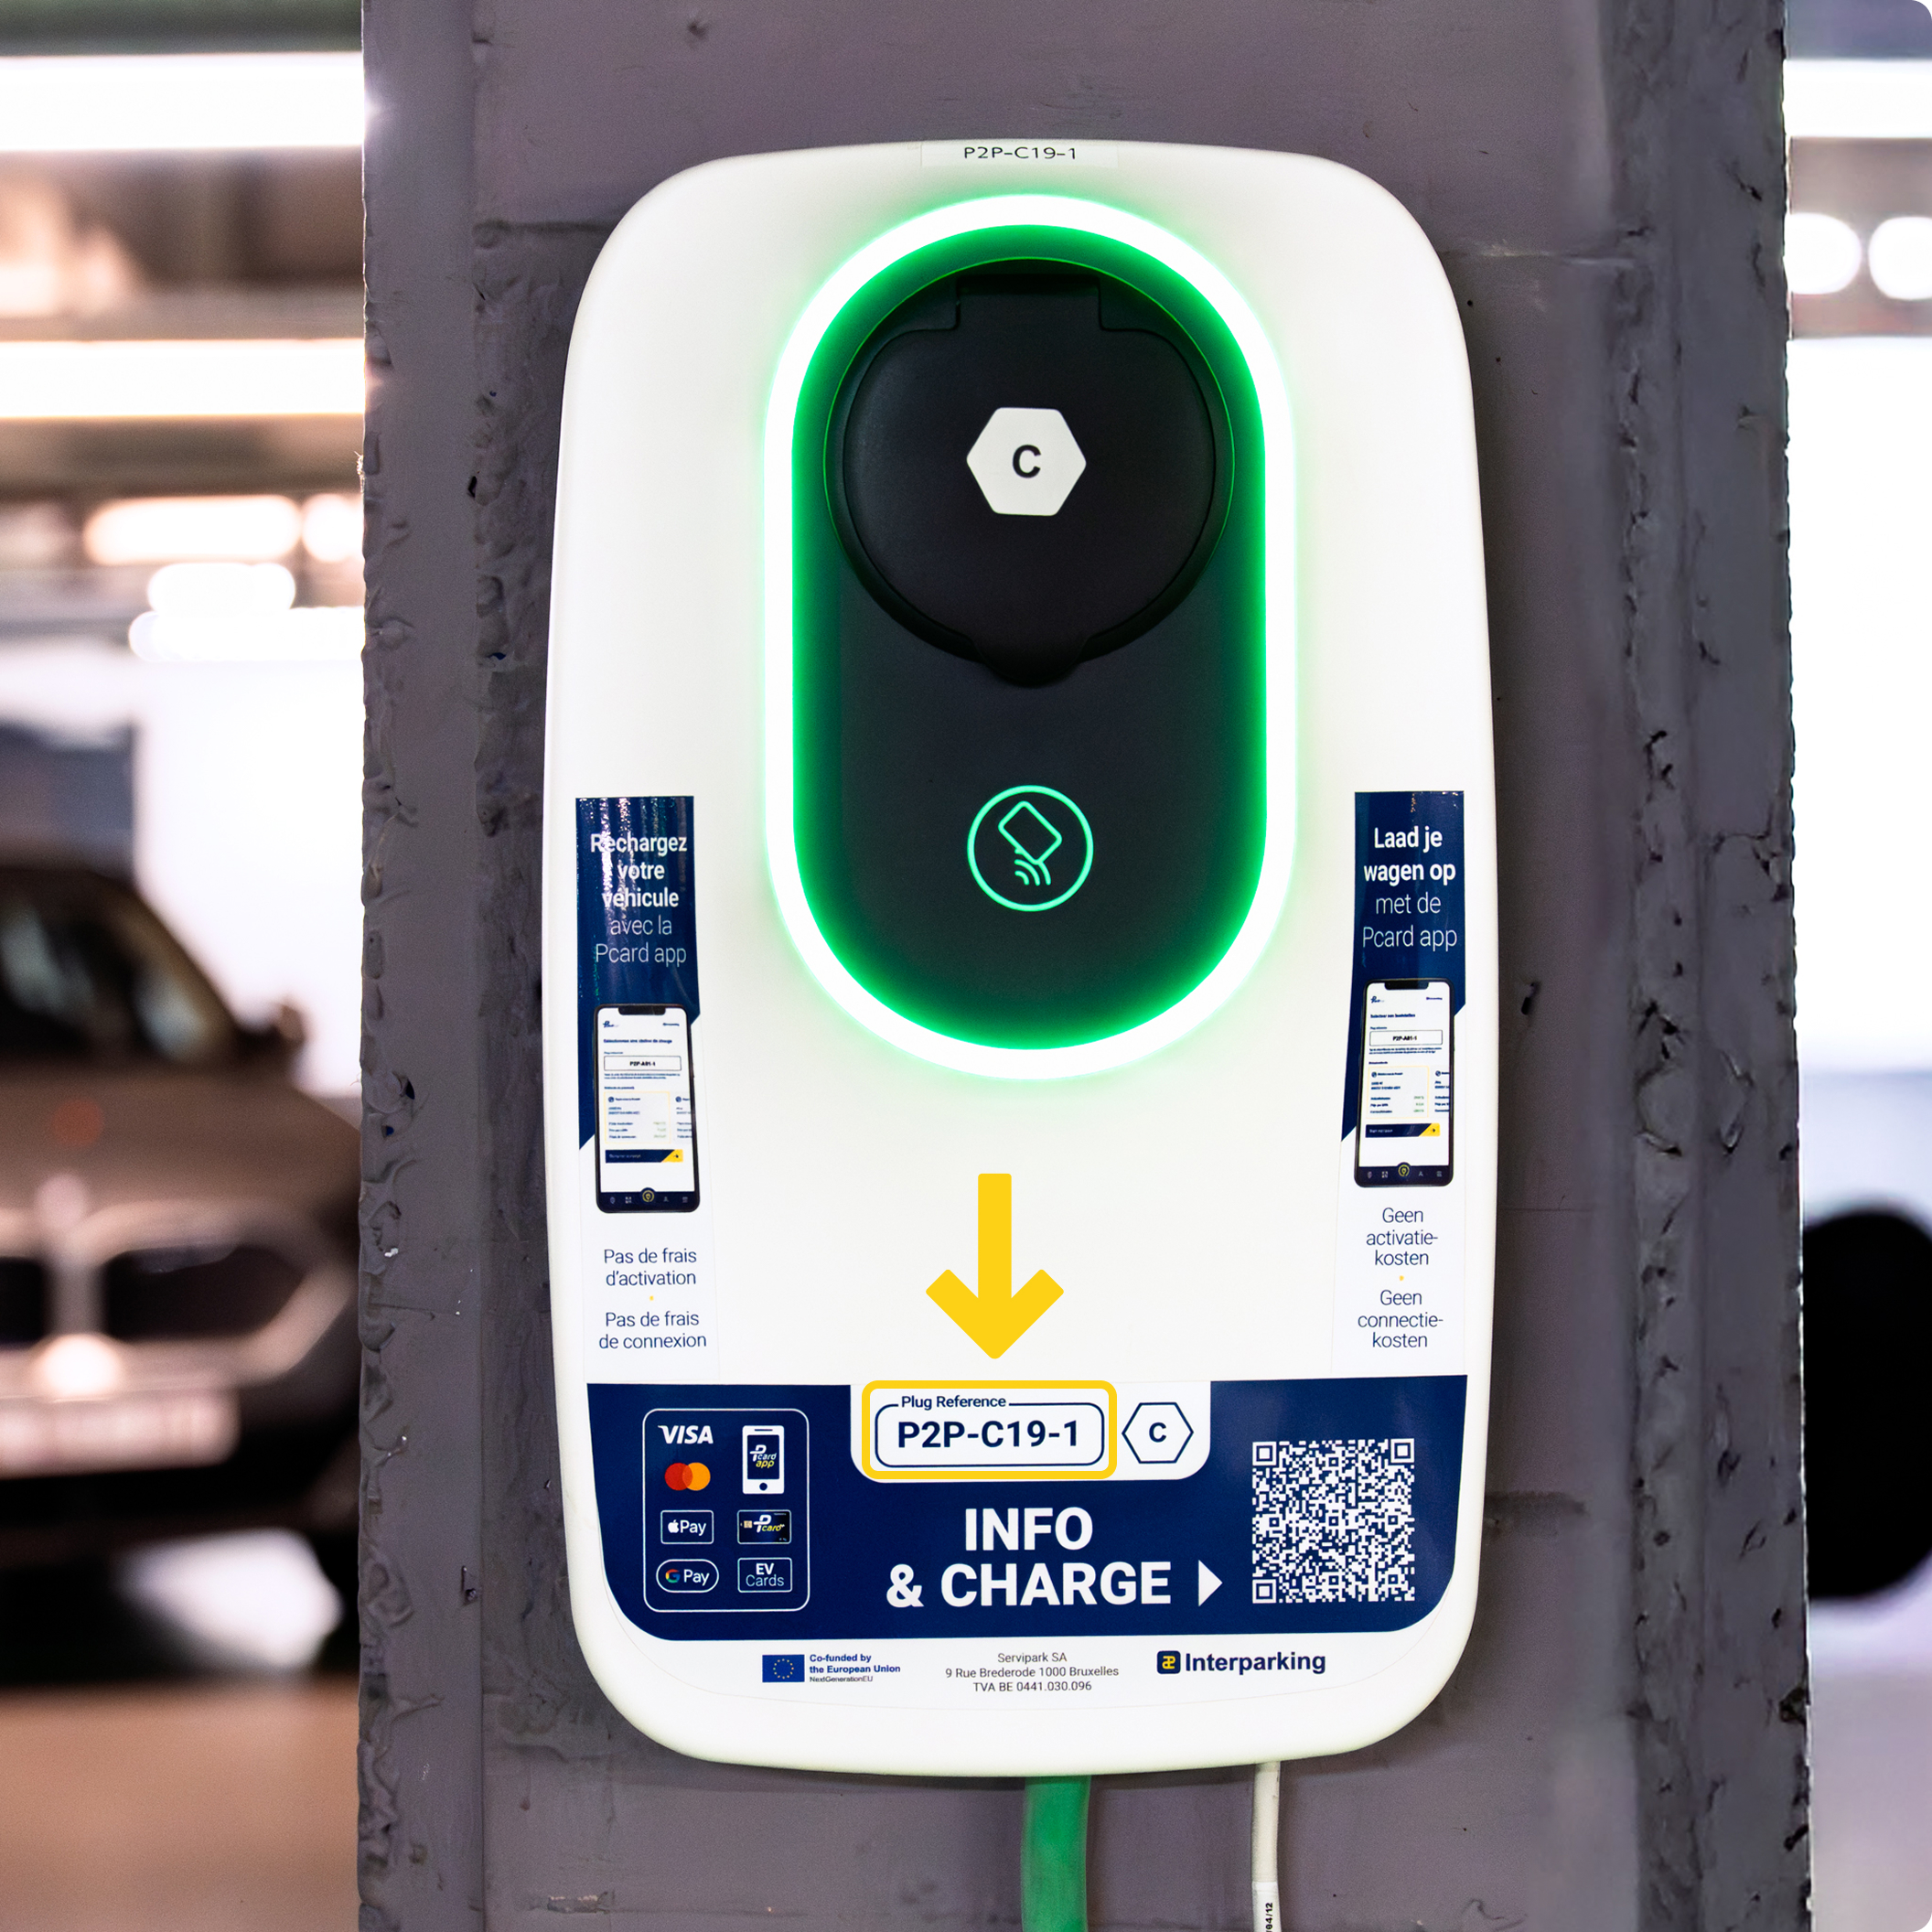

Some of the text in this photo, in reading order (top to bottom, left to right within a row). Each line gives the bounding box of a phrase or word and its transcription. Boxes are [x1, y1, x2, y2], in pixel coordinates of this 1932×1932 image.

[963, 145, 1076, 160] P2P-C19-1
[1013, 445, 1041, 478] C
[590, 832, 688, 858] Rechargez
[1374, 825, 1444, 853] Laad je
[617, 861, 665, 880] votre
[1364, 864, 1455, 886] wagen op
[1377, 892, 1441, 914] met de
[609, 914, 672, 936] avec la
[1362, 924, 1457, 951] Pcard app
[595, 941, 687, 968] Pcard app
[1381, 1207, 1424, 1224] Geen
[1366, 1229, 1439, 1246] activatie-
[604, 1247, 697, 1264] Pas de frais
[1374, 1249, 1430, 1266] kosten
[1379, 1289, 1422, 1306] Geen
[605, 1310, 700, 1327] Pas de frais
[1358, 1311, 1444, 1328] connectie-
[598, 1332, 707, 1349] de connexion
[1372, 1331, 1428, 1348] kosten
[901, 1394, 1007, 1411] Plug Reference
[657, 1424, 714, 1444] VISA
[898, 1421, 1076, 1448] P2P-C19-1
[1149, 1422, 1166, 1443] C
[680, 1519, 707, 1537] Pay
[966, 1507, 1092, 1551] INFO
[756, 1562, 775, 1575] EV
[683, 1568, 710, 1587] Pay
[746, 1572, 785, 1587] Cards
[886, 1562, 1171, 1607] & CHARGE
[809, 1653, 872, 1664] Co-funded by
[997, 1651, 1068, 1666] Servipark SA
[1186, 1652, 1326, 1675] Interparking
[809, 1664, 901, 1675] the European Union
[945, 1666, 1120, 1679] 9 Rue Brederode 1000 Bruxelles
[809, 1675, 874, 1683] NextGenerationEU
[972, 1680, 1092, 1692] TVA BE 0441.030.096
[1264, 1902, 1273, 1932] 04/12
